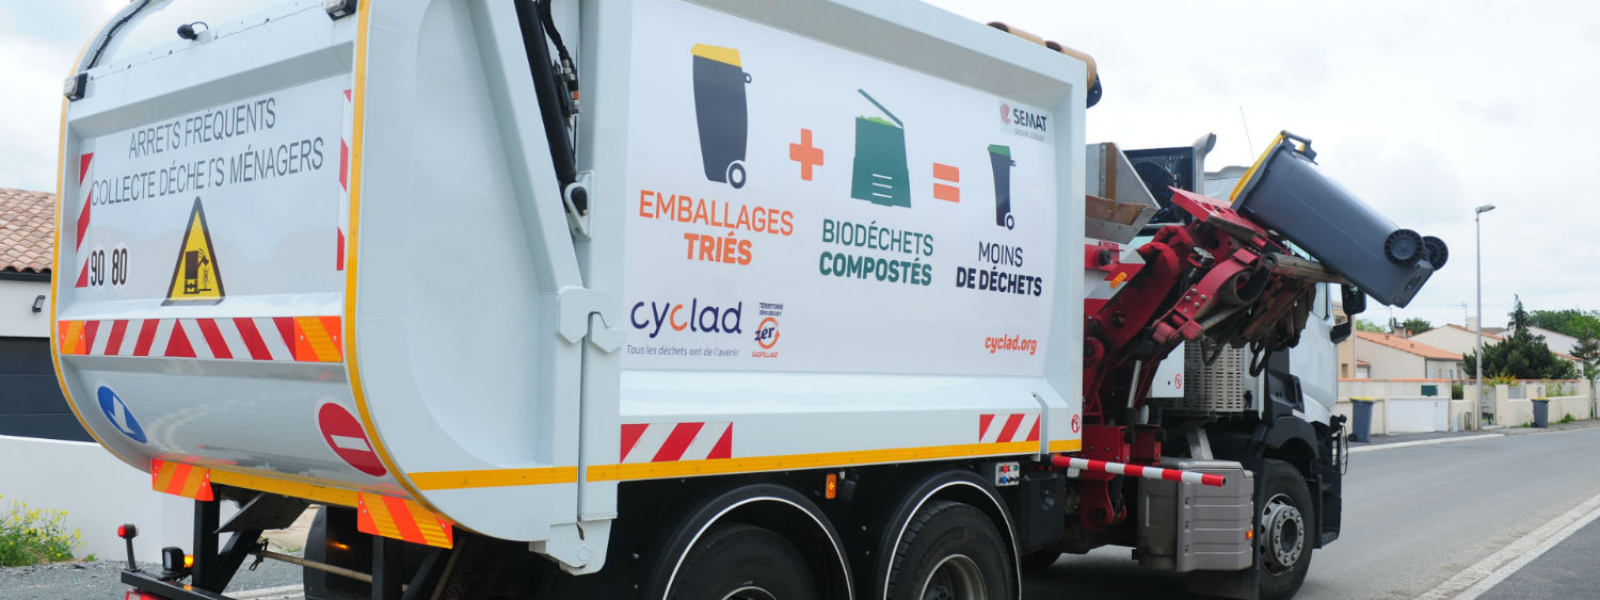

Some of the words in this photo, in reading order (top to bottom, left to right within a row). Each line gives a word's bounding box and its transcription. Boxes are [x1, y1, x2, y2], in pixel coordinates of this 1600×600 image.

[128, 121, 181, 159] ARRETS
[184, 97, 276, 147] FRÉQUENTS
[1013, 108, 1047, 132] SEMAT
[91, 170, 156, 207] COLLECTE
[229, 136, 324, 184] MÉNAGERS
[639, 189, 794, 236] EMBALLAGES
[683, 230, 753, 266] TRIÉS
[822, 218, 934, 257] BIODÉCHETS
[978, 240, 1023, 268] MOINS
[90, 249, 105, 287] 90
[111, 247, 128, 286] 80
[819, 251, 932, 287] COMPOSTÉS
[956, 266, 976, 289] DE
[978, 265, 1042, 297] DÉCHETS
[630, 297, 742, 339] cyclad
[626, 345, 645, 355] Tous
[646, 345, 657, 355] les
[658, 346, 687, 356] déchets
[689, 347, 702, 356] ont
[703, 347, 713, 357] de
[985, 333, 1038, 356] cyclad.org
